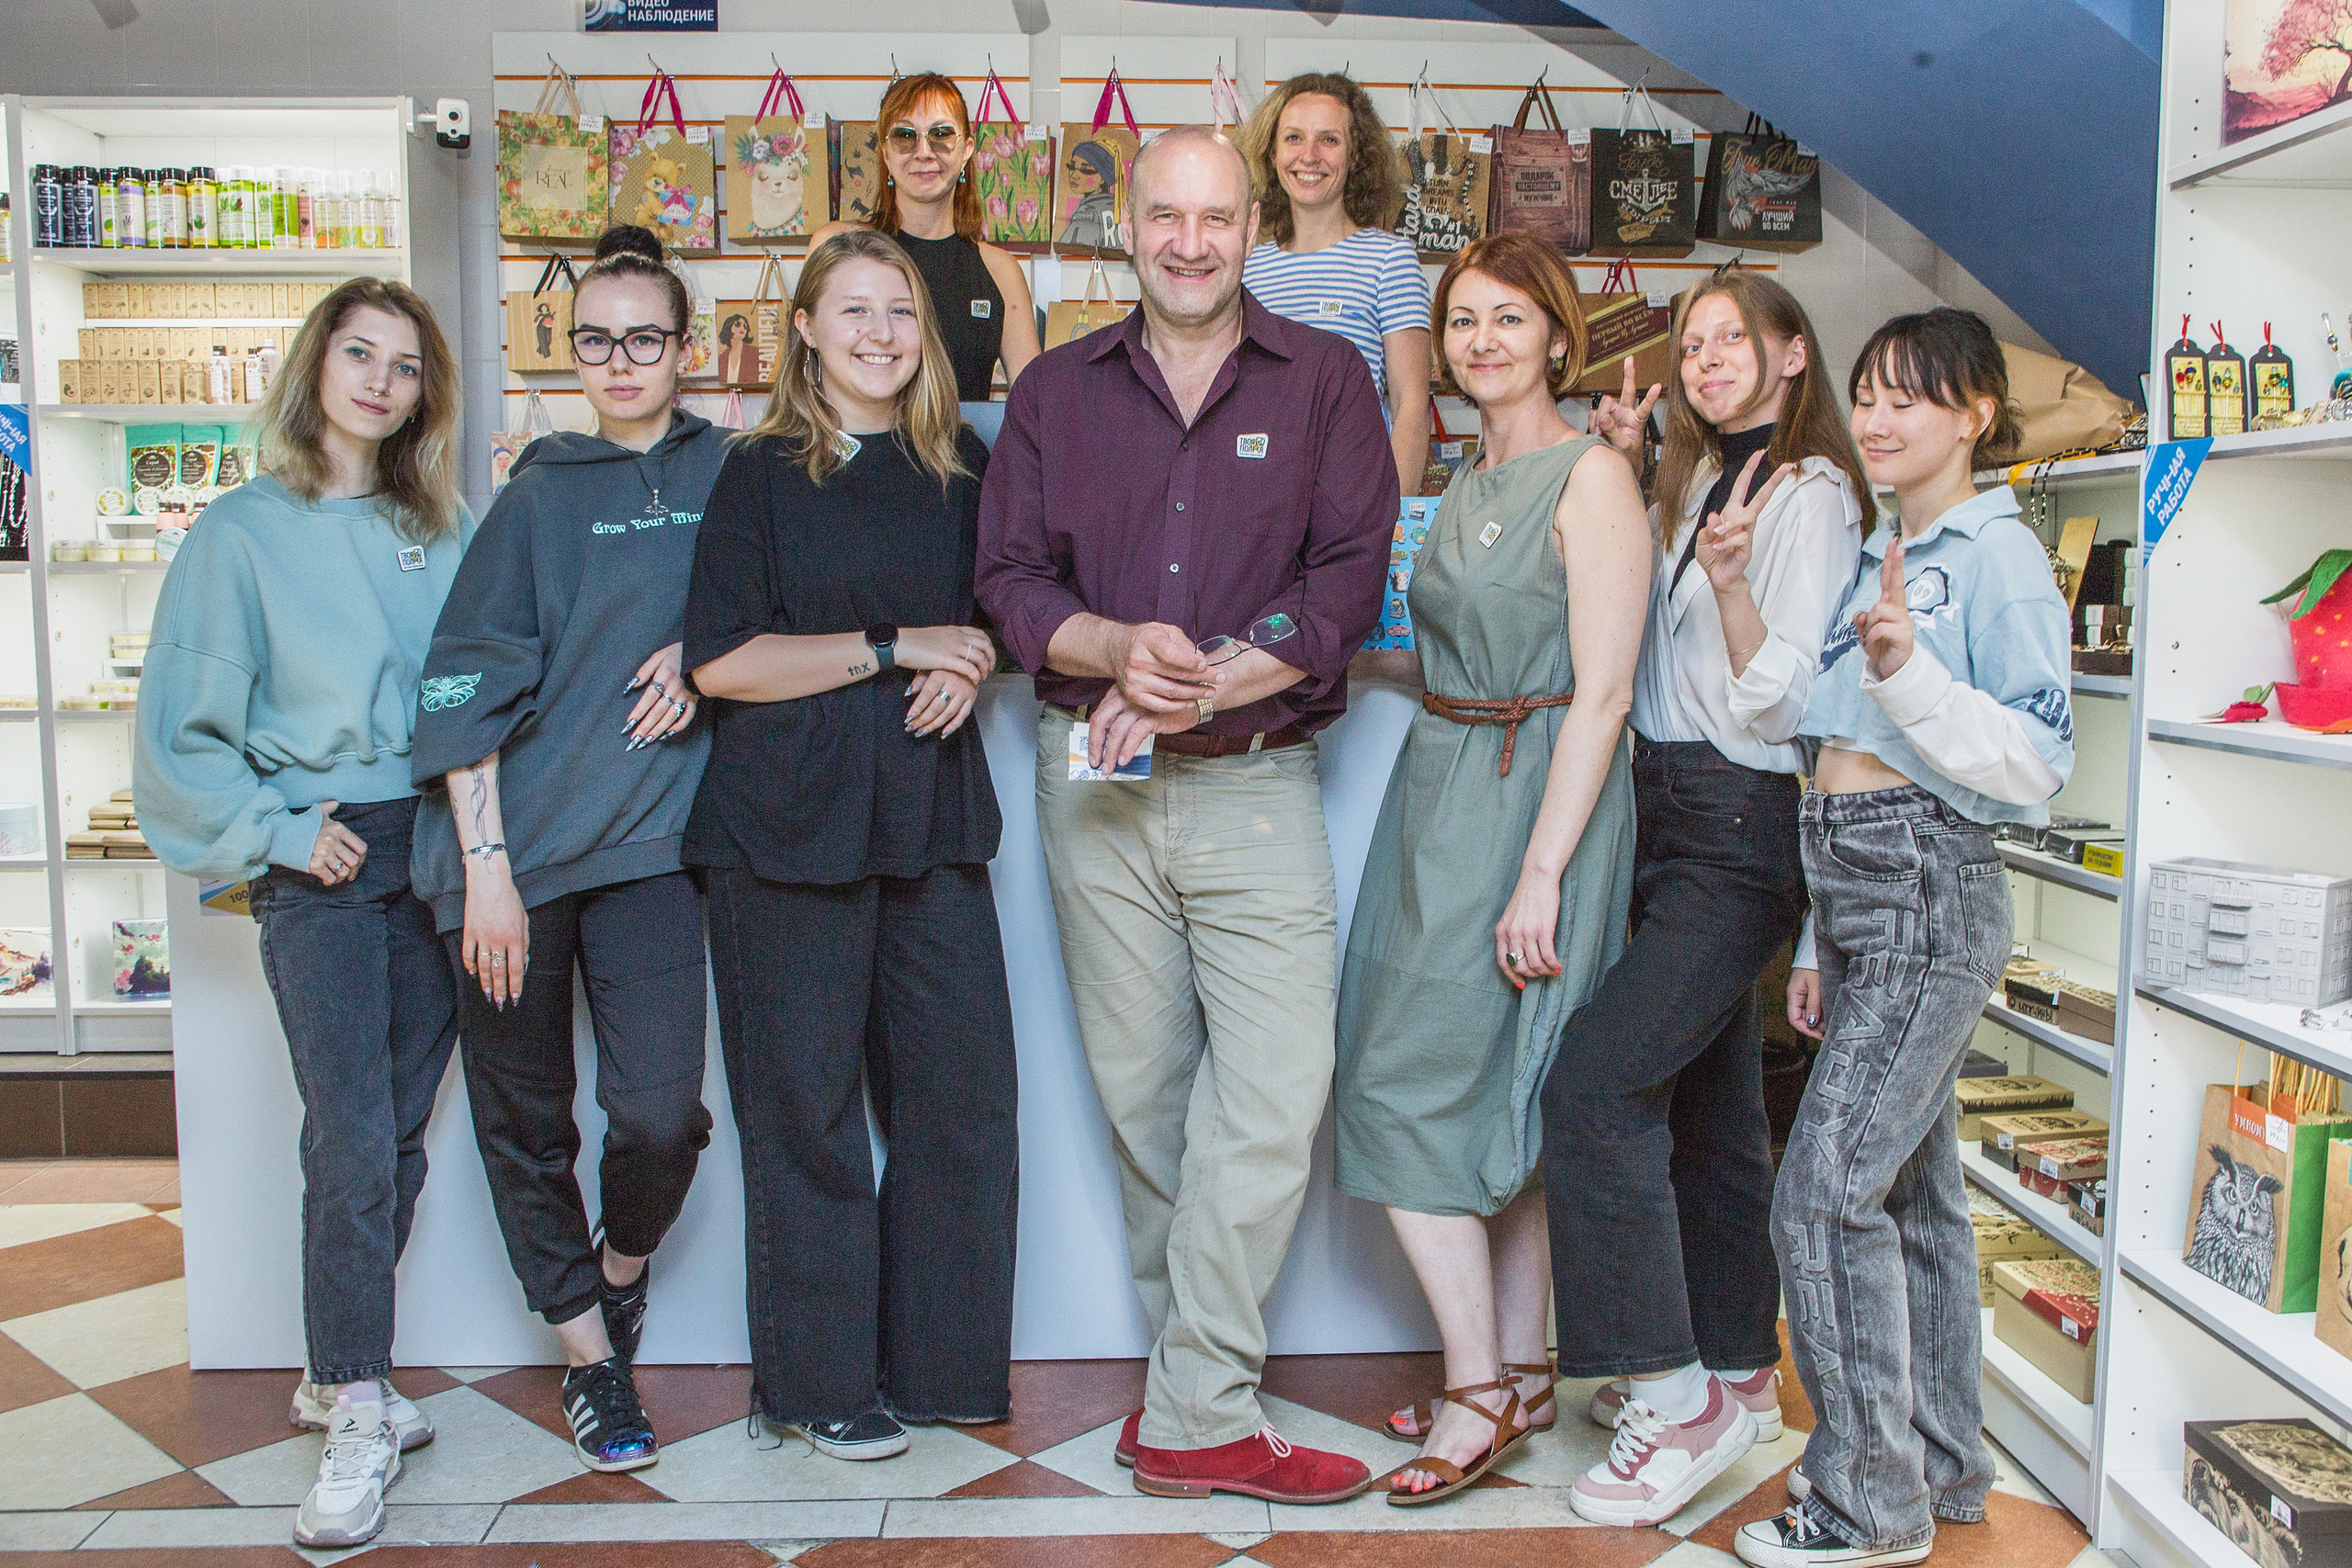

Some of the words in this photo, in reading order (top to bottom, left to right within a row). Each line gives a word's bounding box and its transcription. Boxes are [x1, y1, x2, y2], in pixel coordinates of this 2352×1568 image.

[628, 0, 669, 9] ВИДЕО
[628, 10, 715, 23] НАБЛЮДЕНИЕ
[1521, 171, 1555, 181] ПОДАРОК
[1426, 206, 1449, 215] GOALS
[1762, 210, 1794, 222] ЛУЧШИЙ
[1446, 220, 1462, 235] #1
[1763, 222, 1771, 231] ВО
[1773, 222, 1790, 231] ВСЕМ
[1419, 231, 1470, 251] man
[0, 411, 28, 445] ЧНАЯ
[0, 428, 16, 453] ОТА
[2146, 446, 2187, 515] РУЧНАЯ
[2157, 466, 2193, 526] РАБОТА
[592, 522, 626, 534] Grow
[630, 517, 665, 530] Your
[1914, 584, 1930, 600] 89
[230, 889, 248, 904] 100
